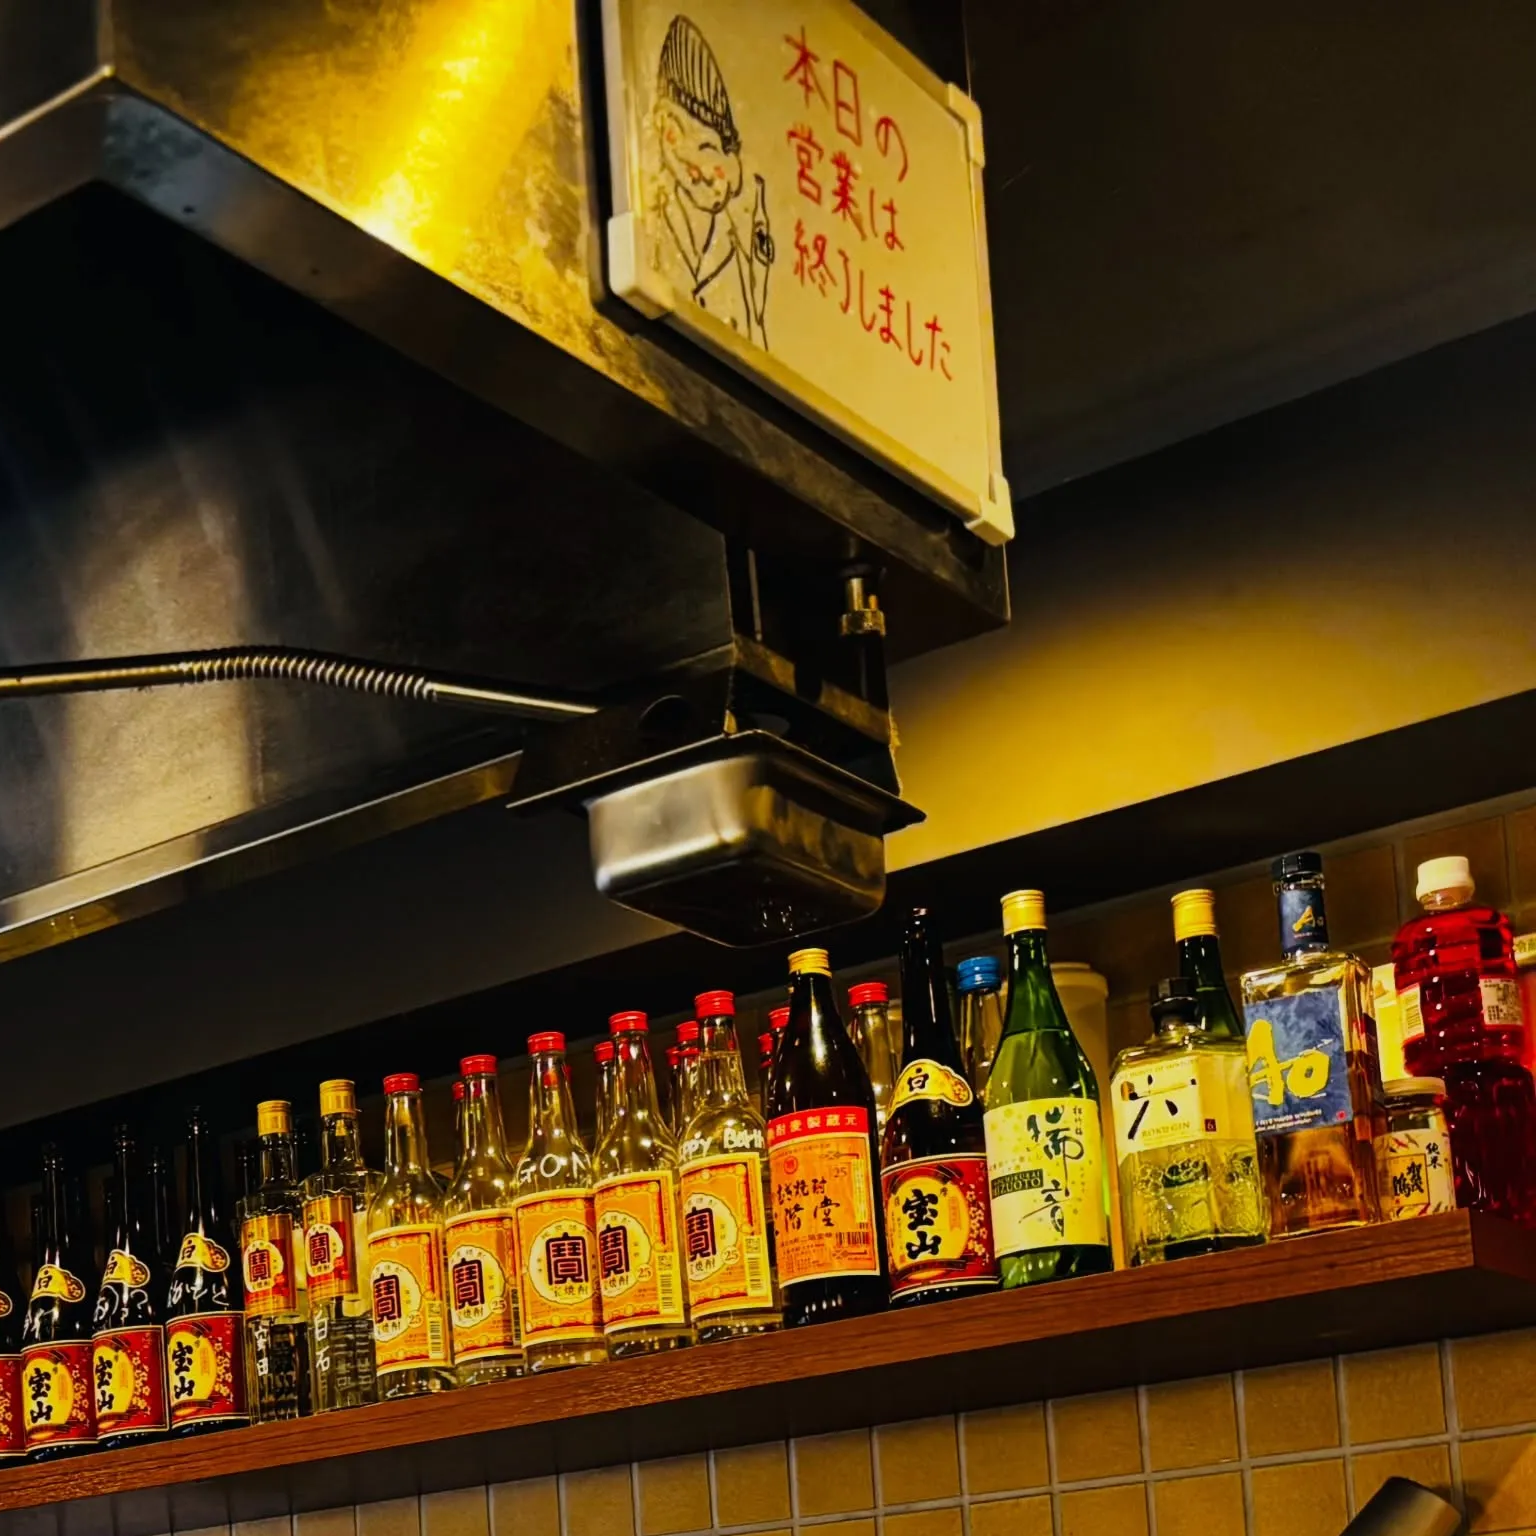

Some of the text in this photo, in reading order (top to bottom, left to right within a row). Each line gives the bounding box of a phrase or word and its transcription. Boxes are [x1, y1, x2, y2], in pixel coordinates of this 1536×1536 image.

[783, 27, 909, 182] 本日の
[786, 122, 905, 251] 営業は
[793, 220, 953, 381] 終了しました
[902, 1188, 942, 1260] 宝山
[637, 1267, 652, 1280] 25
[724, 1249, 739, 1262] 25
[28, 1367, 54, 1424] 宝山
[94, 1355, 115, 1413] 宝山
[171, 1341, 196, 1399] 宝山
